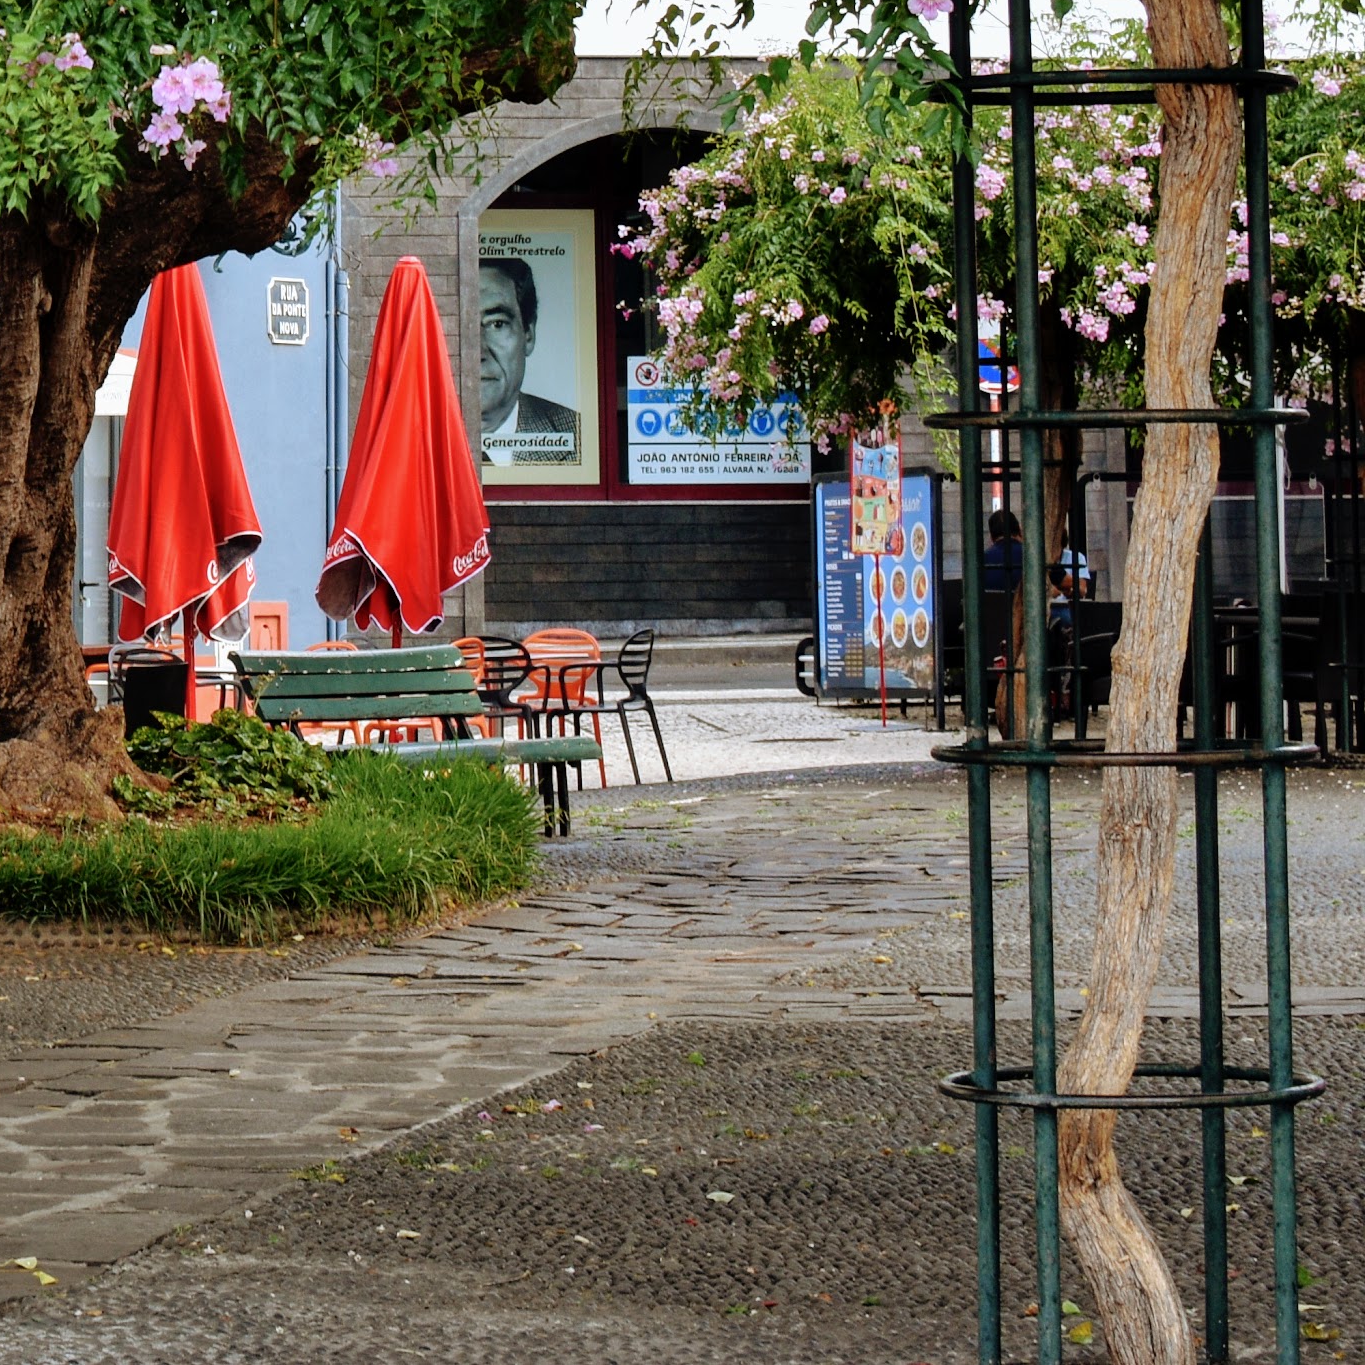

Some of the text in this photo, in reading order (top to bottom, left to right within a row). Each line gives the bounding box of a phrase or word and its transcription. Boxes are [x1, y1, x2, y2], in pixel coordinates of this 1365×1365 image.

[489, 234, 532, 246] orgulho
[479, 246, 566, 255] Olim Perestrelo
[280, 284, 299, 301] RUA
[272, 302, 306, 317] DA PONTE
[279, 321, 299, 335] NOVA
[482, 435, 570, 450] Generosidade
[637, 452, 667, 463] JOÃO
[671, 452, 720, 462] ANTÓNIO
[724, 453, 774, 462] FERREIRA
[641, 466, 657, 474] TEL:
[660, 466, 679, 474] 963
[681, 466, 696, 474] 182
[698, 466, 715, 474] 655
[723, 465, 754, 474] ALVARÁ
